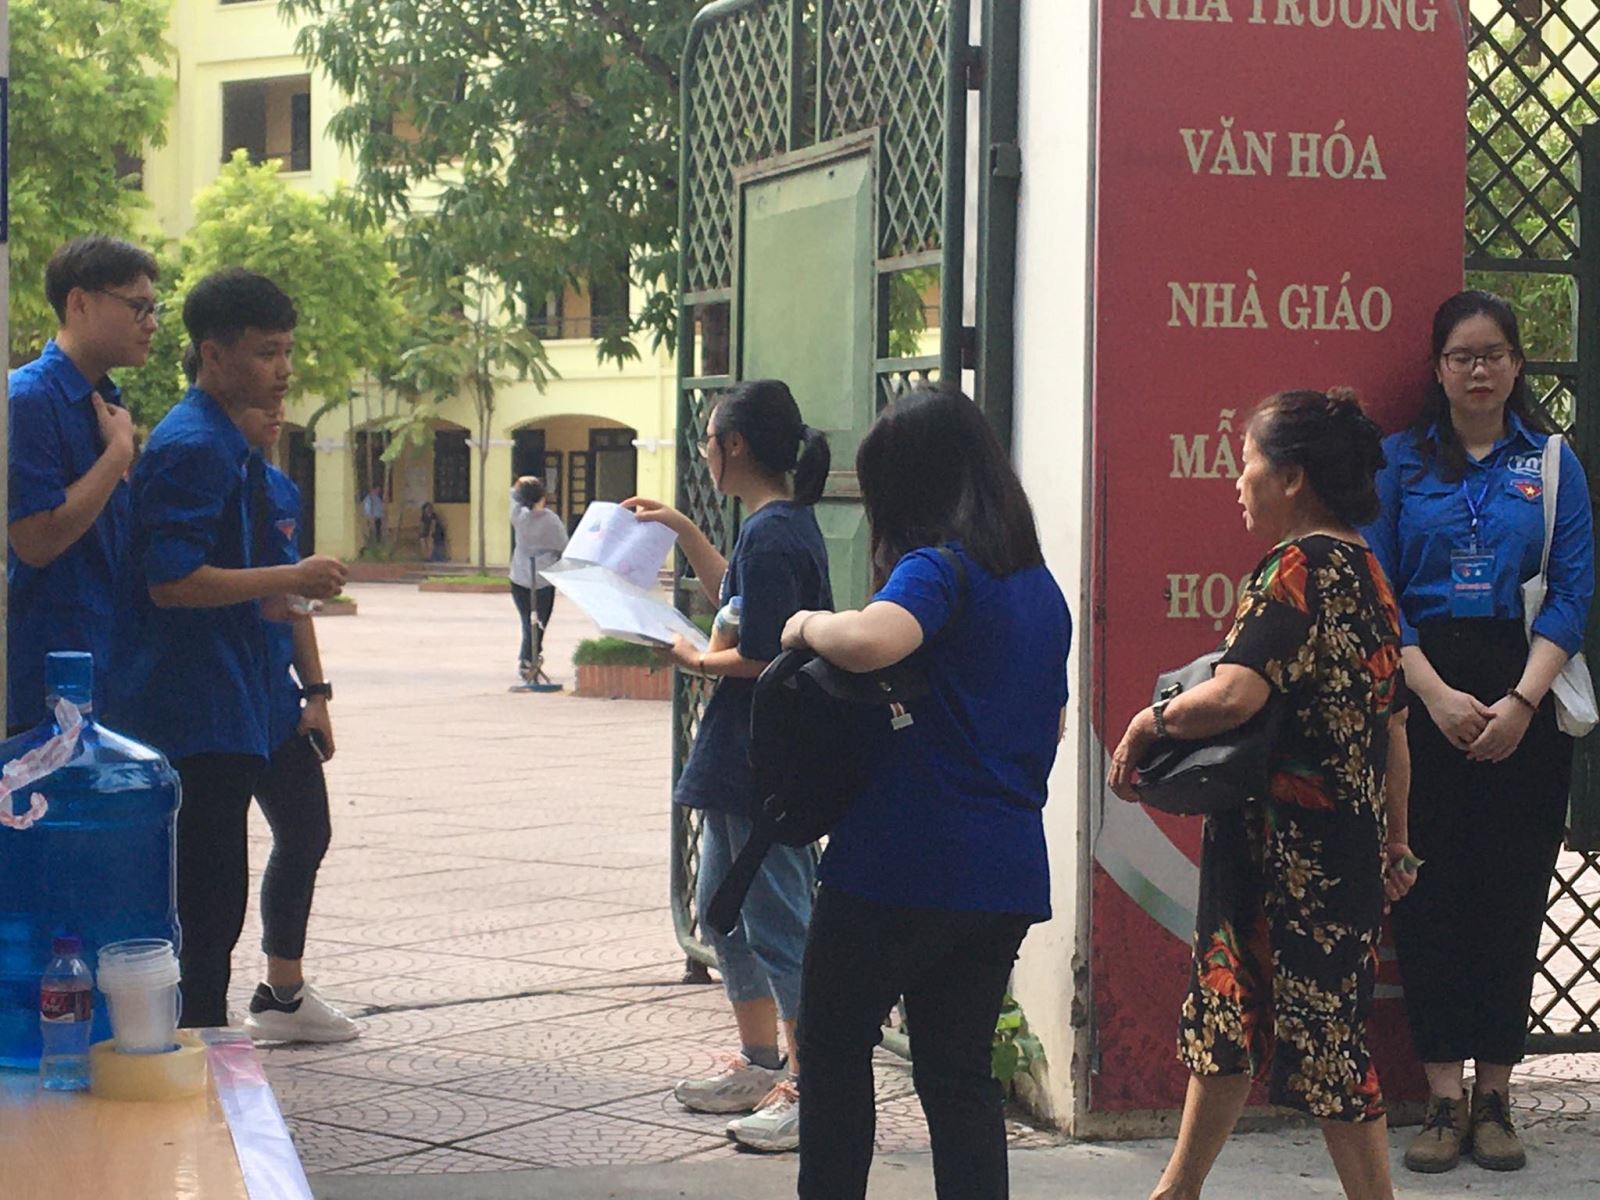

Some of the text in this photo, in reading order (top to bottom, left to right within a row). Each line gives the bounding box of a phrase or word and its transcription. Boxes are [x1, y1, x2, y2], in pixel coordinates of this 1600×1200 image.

[1179, 115, 1387, 180] VĂN HÓA
[1167, 268, 1392, 332] NHÀ GIÁO
[1169, 408, 1245, 478] MẪ
[1166, 572, 1252, 631] HỌ
